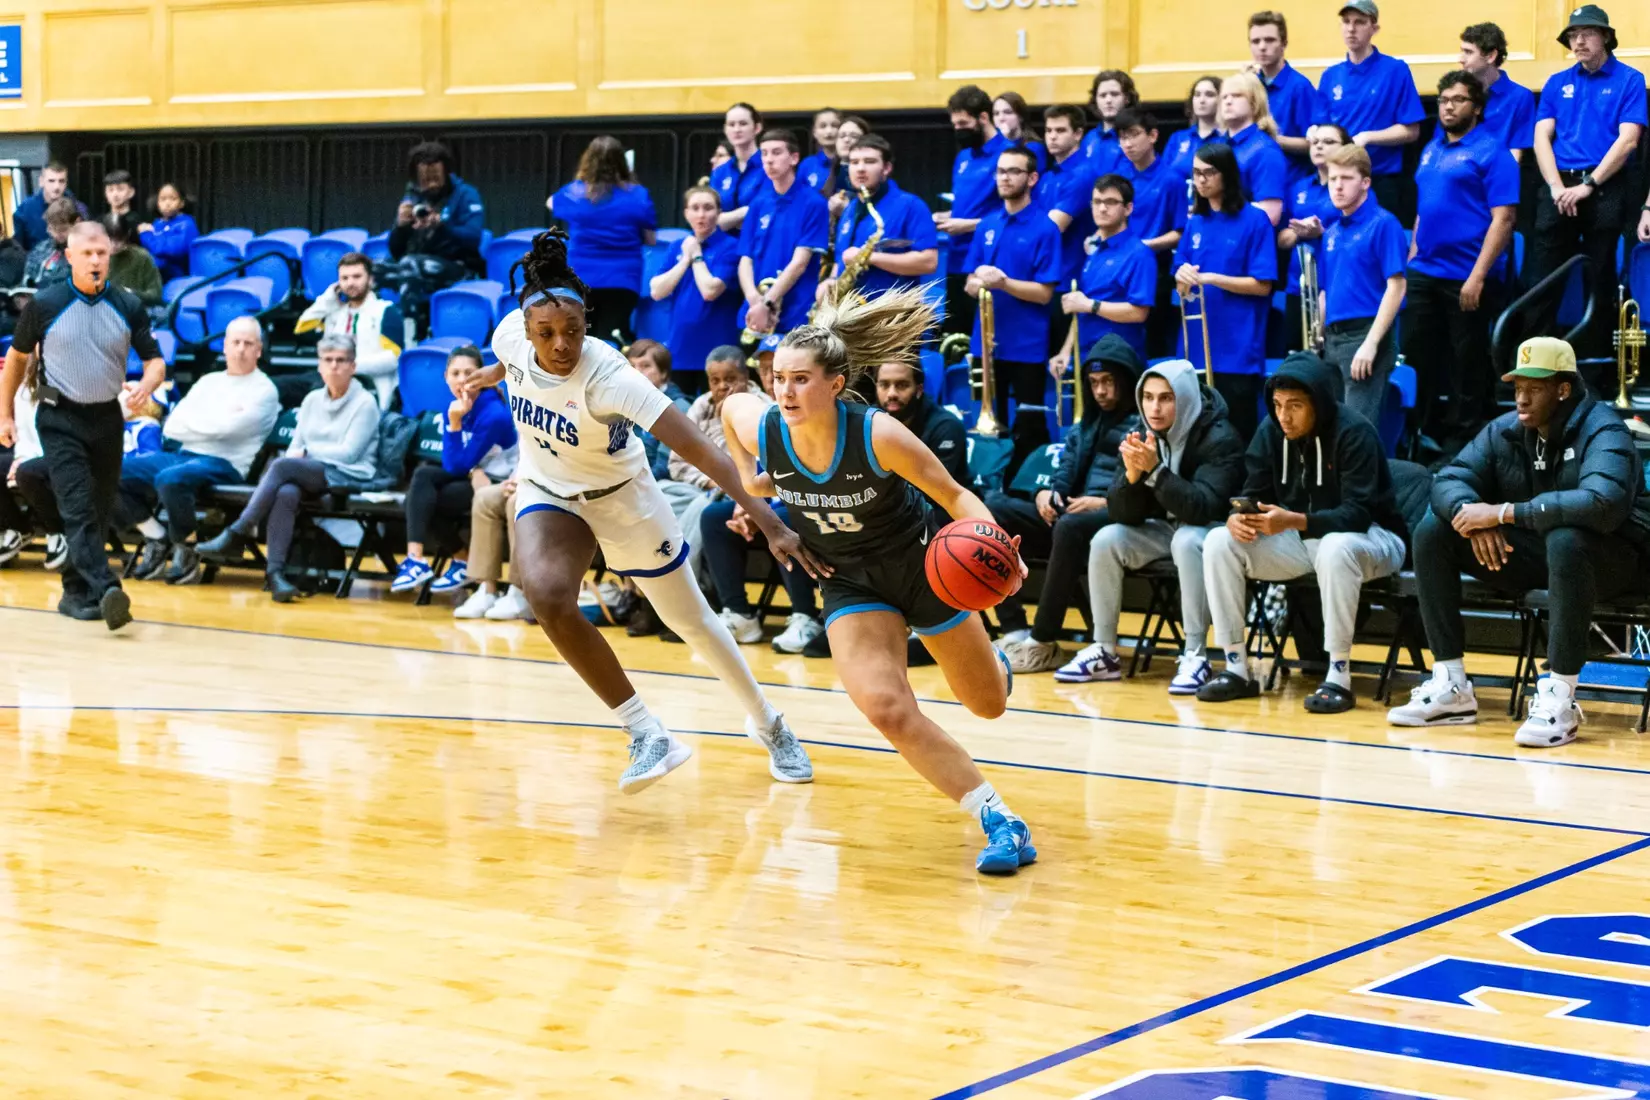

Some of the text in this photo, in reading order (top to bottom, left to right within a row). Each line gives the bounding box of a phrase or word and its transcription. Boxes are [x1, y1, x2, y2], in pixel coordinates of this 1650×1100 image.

[1521, 346, 1531, 364] S
[511, 395, 579, 447] PIRATES
[775, 484, 877, 509] COLUMBIA
[971, 546, 1012, 581] NCAA
